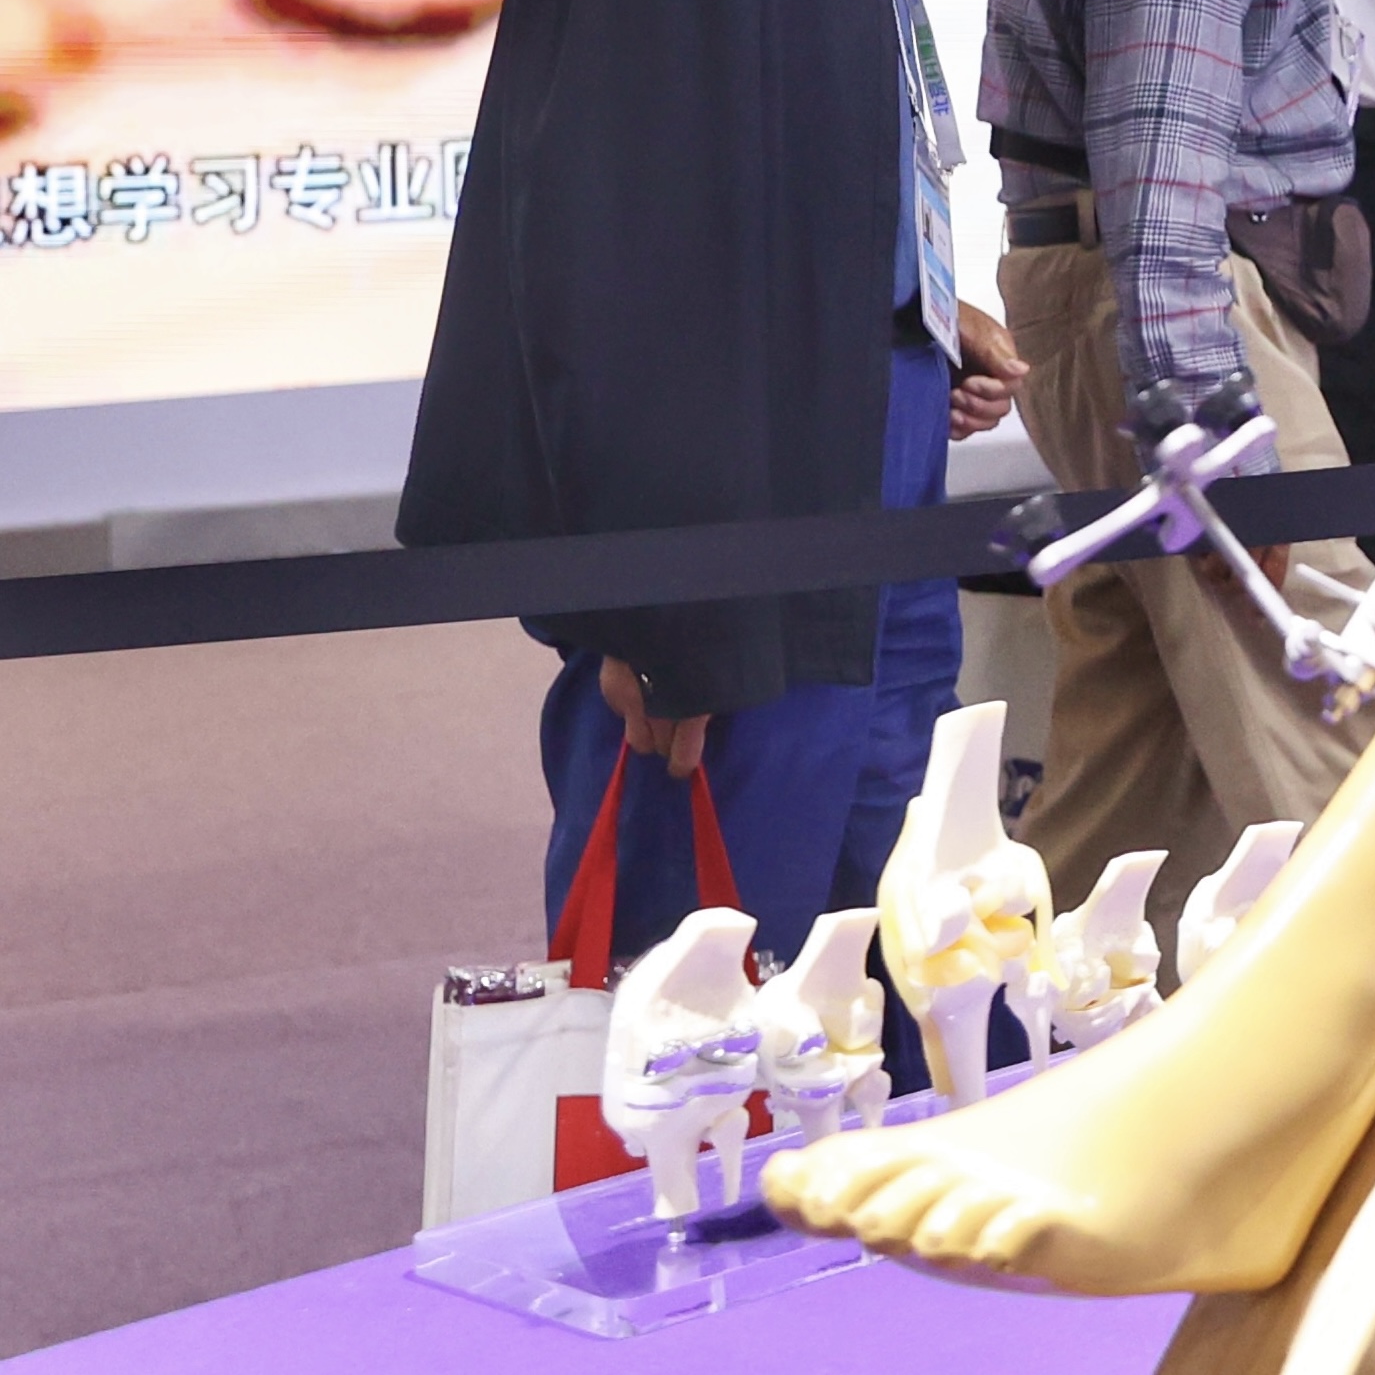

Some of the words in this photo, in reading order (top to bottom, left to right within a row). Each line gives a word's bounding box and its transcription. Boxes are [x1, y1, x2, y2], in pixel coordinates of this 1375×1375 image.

[0, 133, 473, 247] 想学习专业
